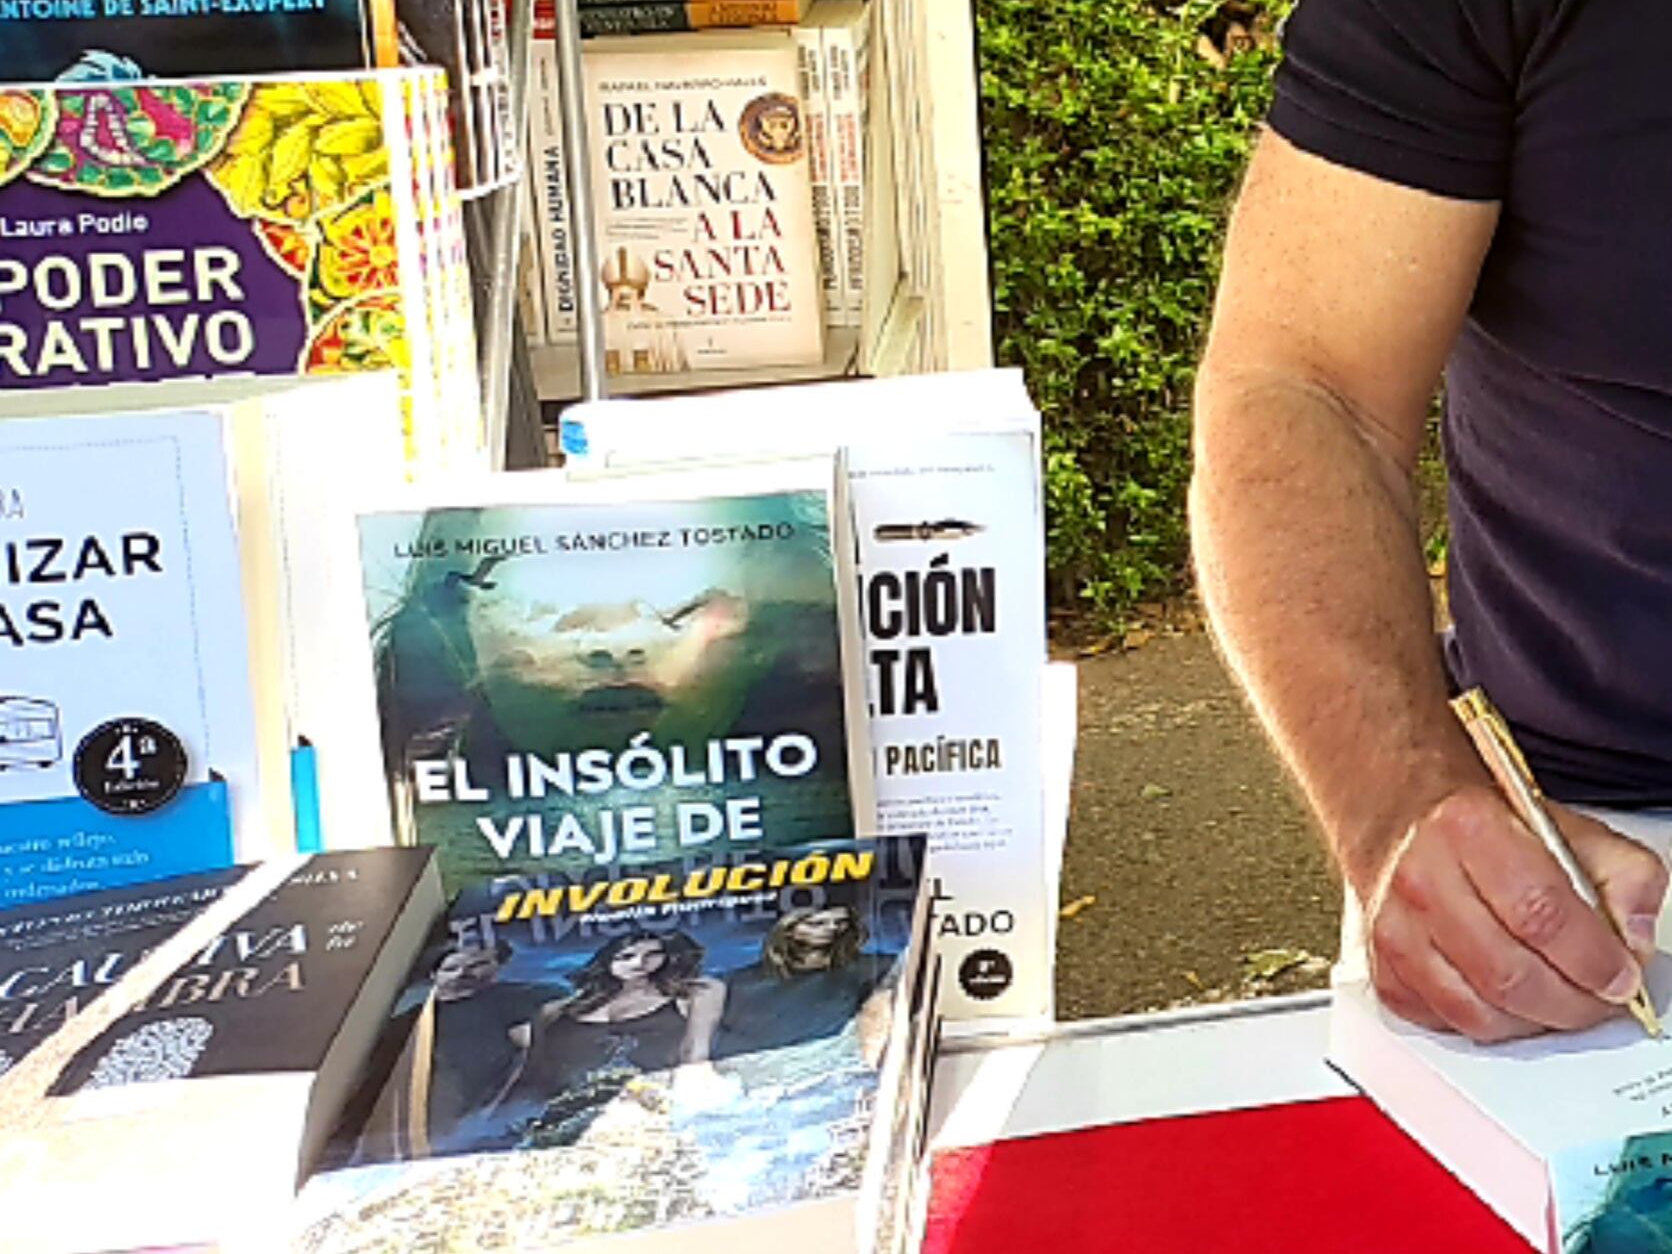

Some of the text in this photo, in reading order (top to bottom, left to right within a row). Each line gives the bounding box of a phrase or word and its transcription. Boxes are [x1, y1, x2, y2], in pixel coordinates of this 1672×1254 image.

[603, 98, 728, 137] DE LA
[605, 138, 713, 174] CASA
[611, 171, 777, 211] BLANCA
[1, 216, 74, 238] Laura
[543, 145, 576, 314] DIGNIDAD HUMANA
[692, 207, 783, 243] A LA
[653, 246, 787, 281] SANTA
[683, 281, 792, 318] SEDE
[6, 531, 164, 585] IZAR
[393, 520, 796, 560] LUIS MIGUEL SÁNCHEZ TOSTADO
[857, 552, 997, 640] CIÓN
[414, 730, 820, 803] EL INSÓLITO
[885, 734, 1002, 776] PACÍFICA
[477, 796, 766, 864] VIAJE DE
[496, 847, 876, 924] INVOLUCIÓN
[1592, 1156, 1654, 1178] LUIS
